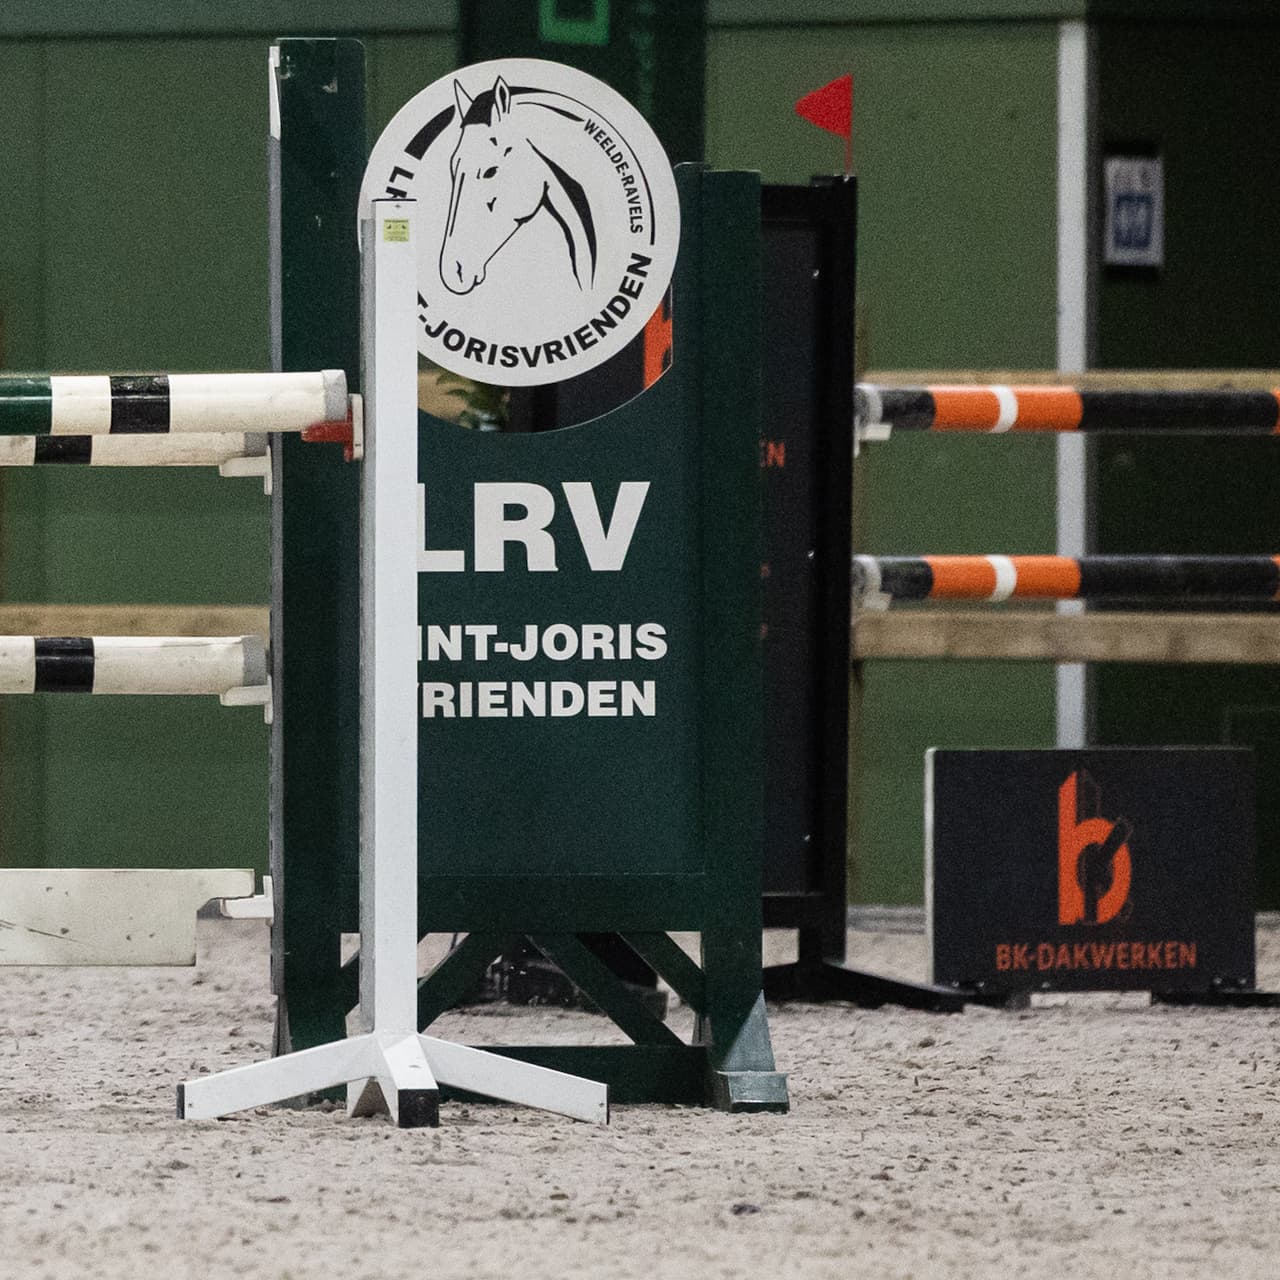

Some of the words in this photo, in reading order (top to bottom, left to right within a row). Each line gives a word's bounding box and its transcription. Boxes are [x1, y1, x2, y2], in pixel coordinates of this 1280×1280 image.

[583, 118, 644, 234] WEELDE-RAVELS
[417, 680, 656, 717] RIENDEN
[995, 941, 1198, 970] BK-DAKWERKEN
